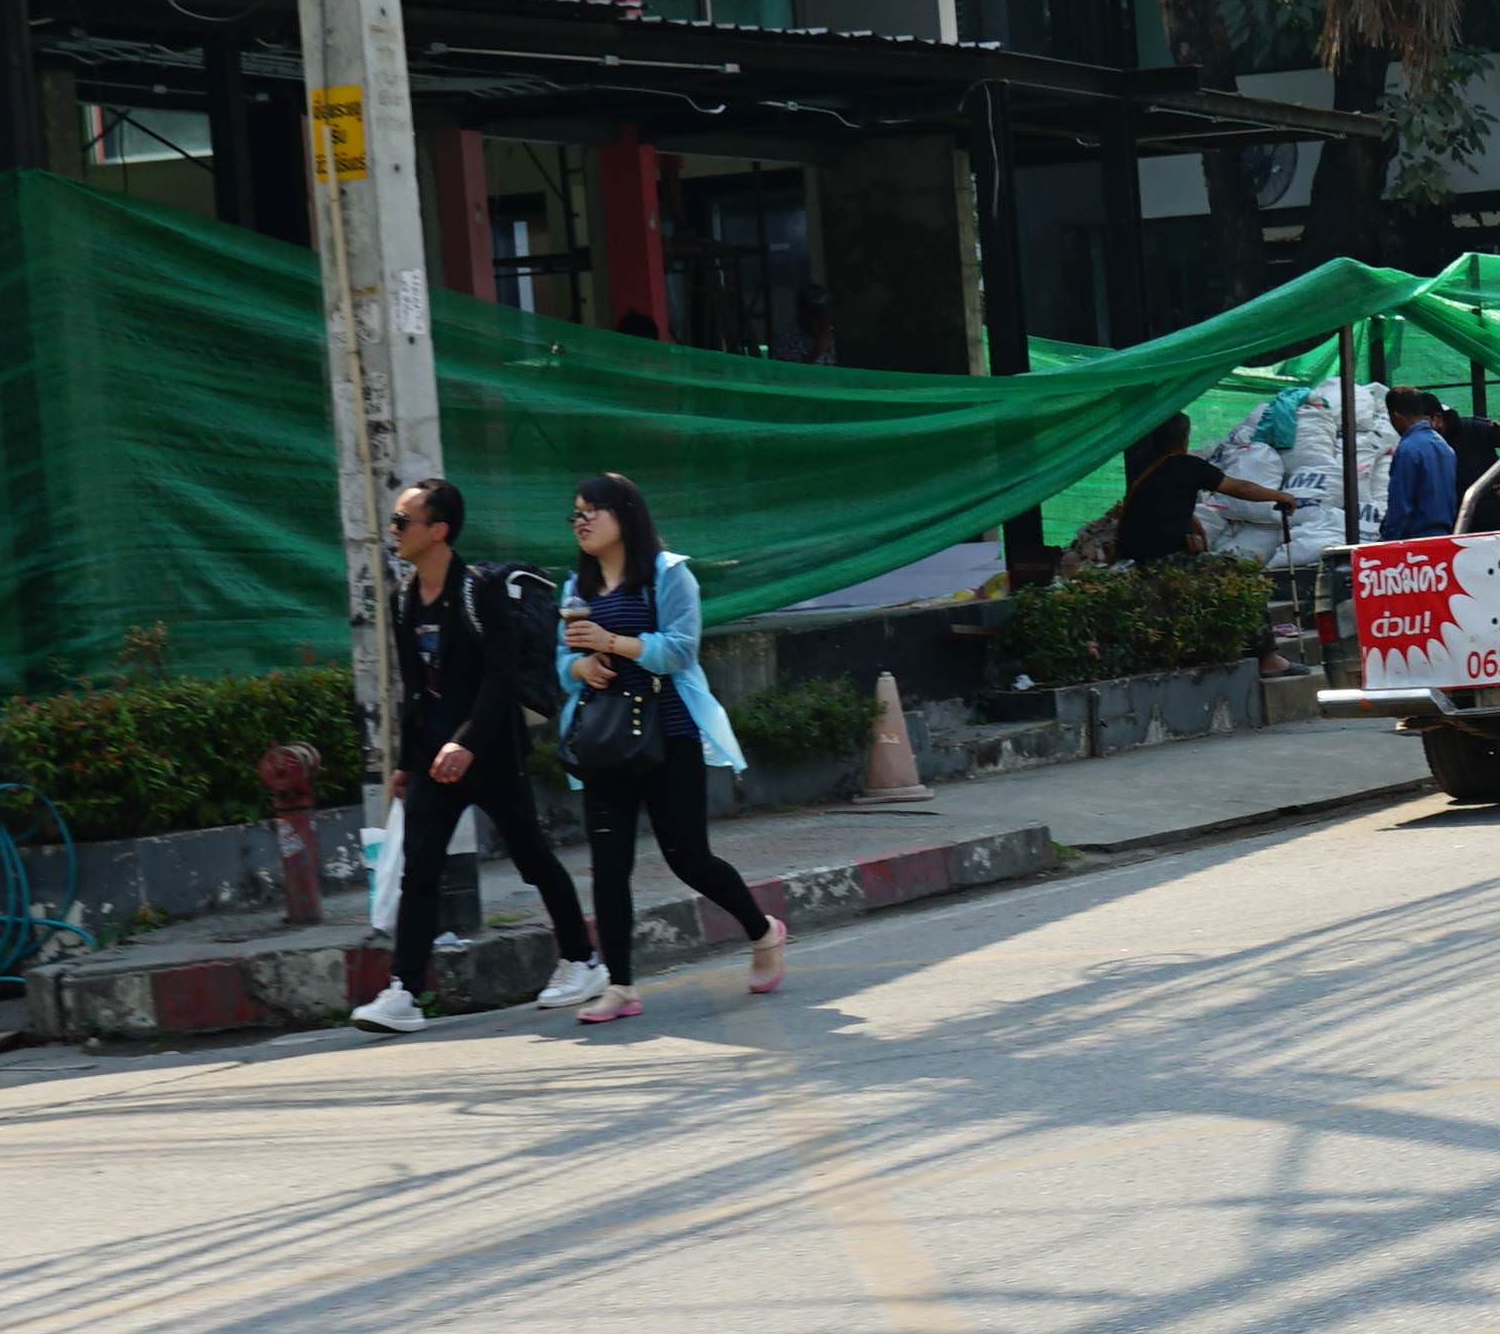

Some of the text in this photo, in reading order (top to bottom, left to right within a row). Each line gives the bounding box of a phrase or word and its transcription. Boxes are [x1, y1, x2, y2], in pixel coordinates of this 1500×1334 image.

[1357, 551, 1449, 599] รับสมัคร
[1371, 611, 1431, 639] ด่วน!
